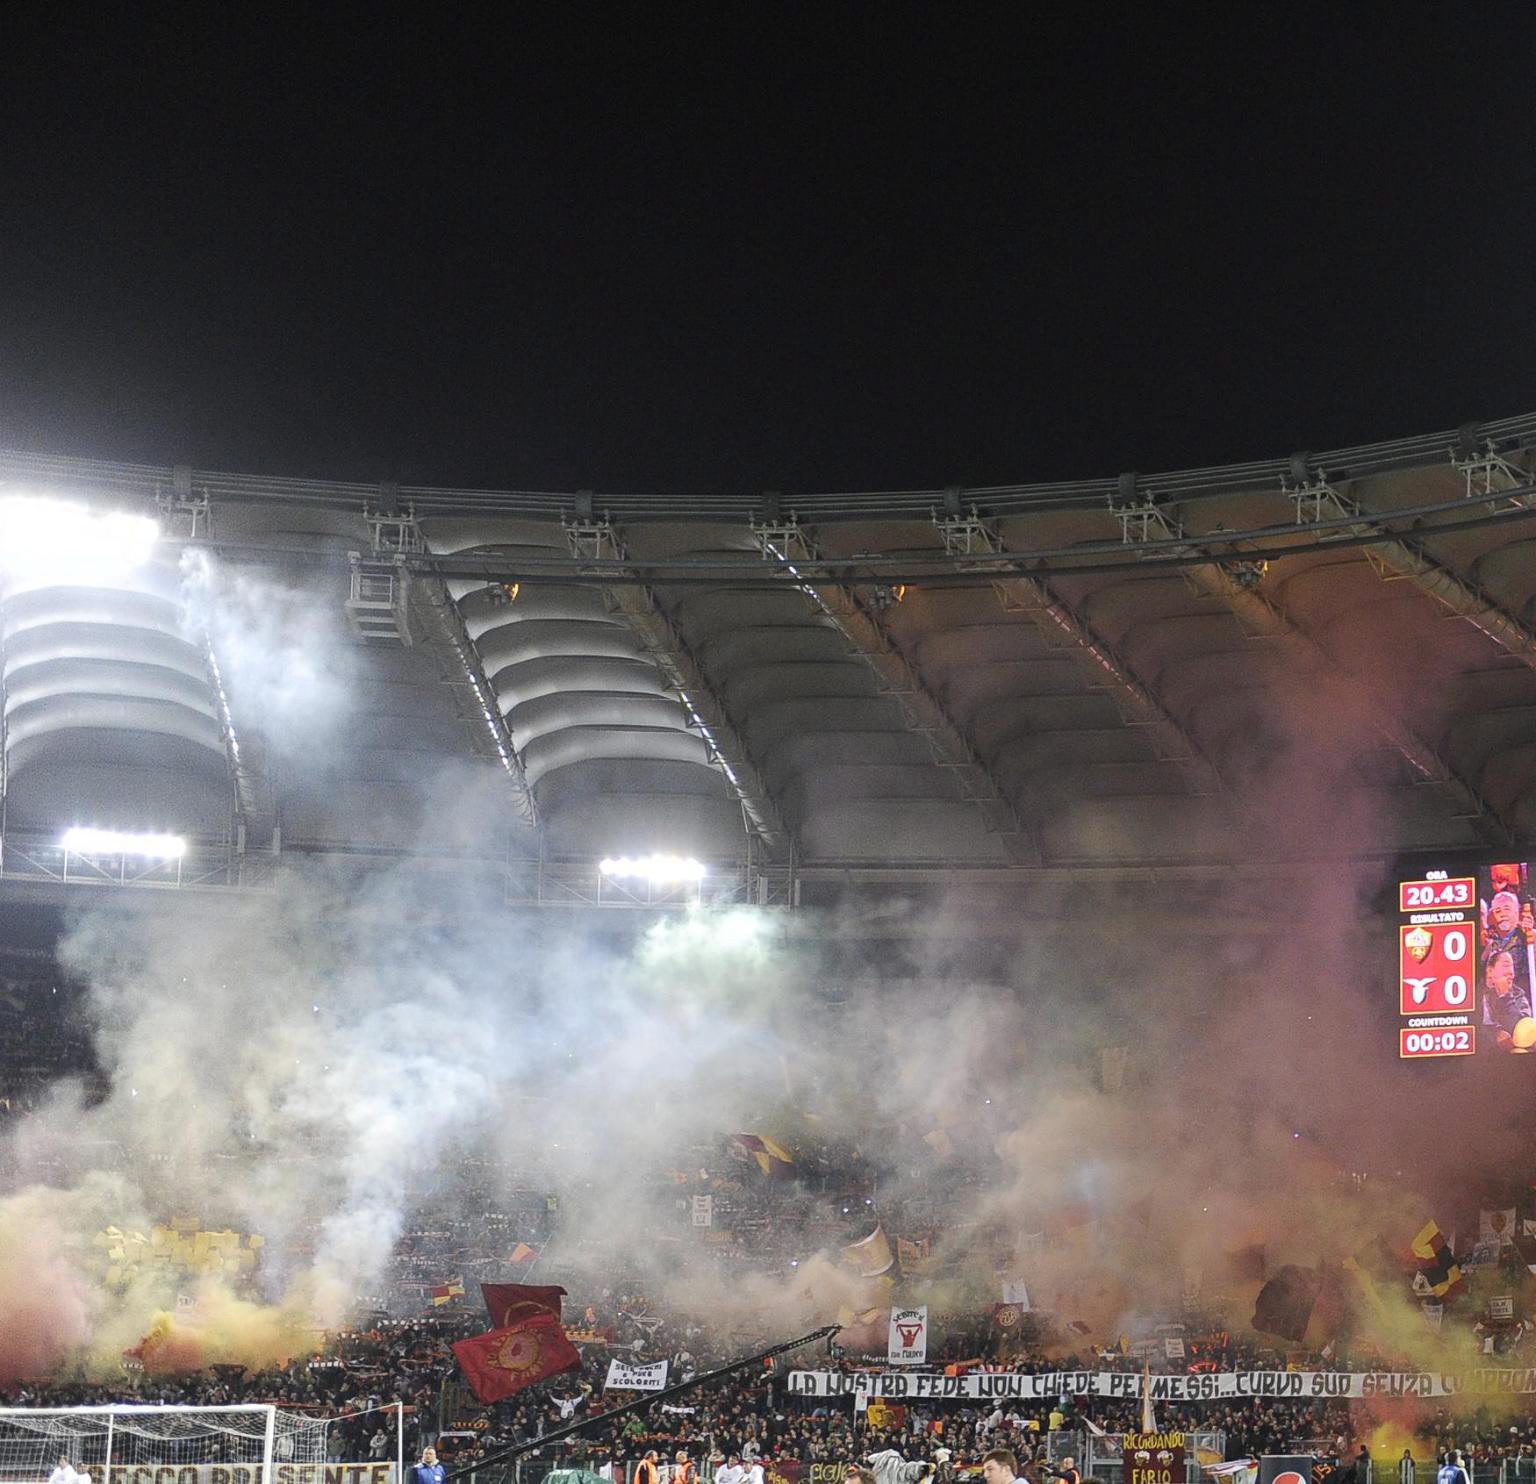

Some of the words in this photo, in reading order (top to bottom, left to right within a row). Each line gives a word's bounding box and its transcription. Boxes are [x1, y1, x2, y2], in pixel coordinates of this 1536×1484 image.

[1426, 870, 1448, 880] ORA
[1407, 884, 1468, 905] 20.43
[1443, 931, 1466, 961] 0
[1444, 975, 1467, 1005] 0
[1408, 1016, 1468, 1027] COUNTDOWN
[1406, 1031, 1469, 1053] 00:02
[612, 1378, 660, 1386] SCOLORITI
[790, 1374, 817, 1396] LA
[826, 1373, 908, 1396] NOSTRA
[917, 1375, 970, 1397] FEDE
[978, 1375, 1022, 1397] NON
[1311, 1373, 1351, 1395] SUD
[1362, 1373, 1433, 1397] SENZA
[1123, 1431, 1185, 1450] RICORDANDO
